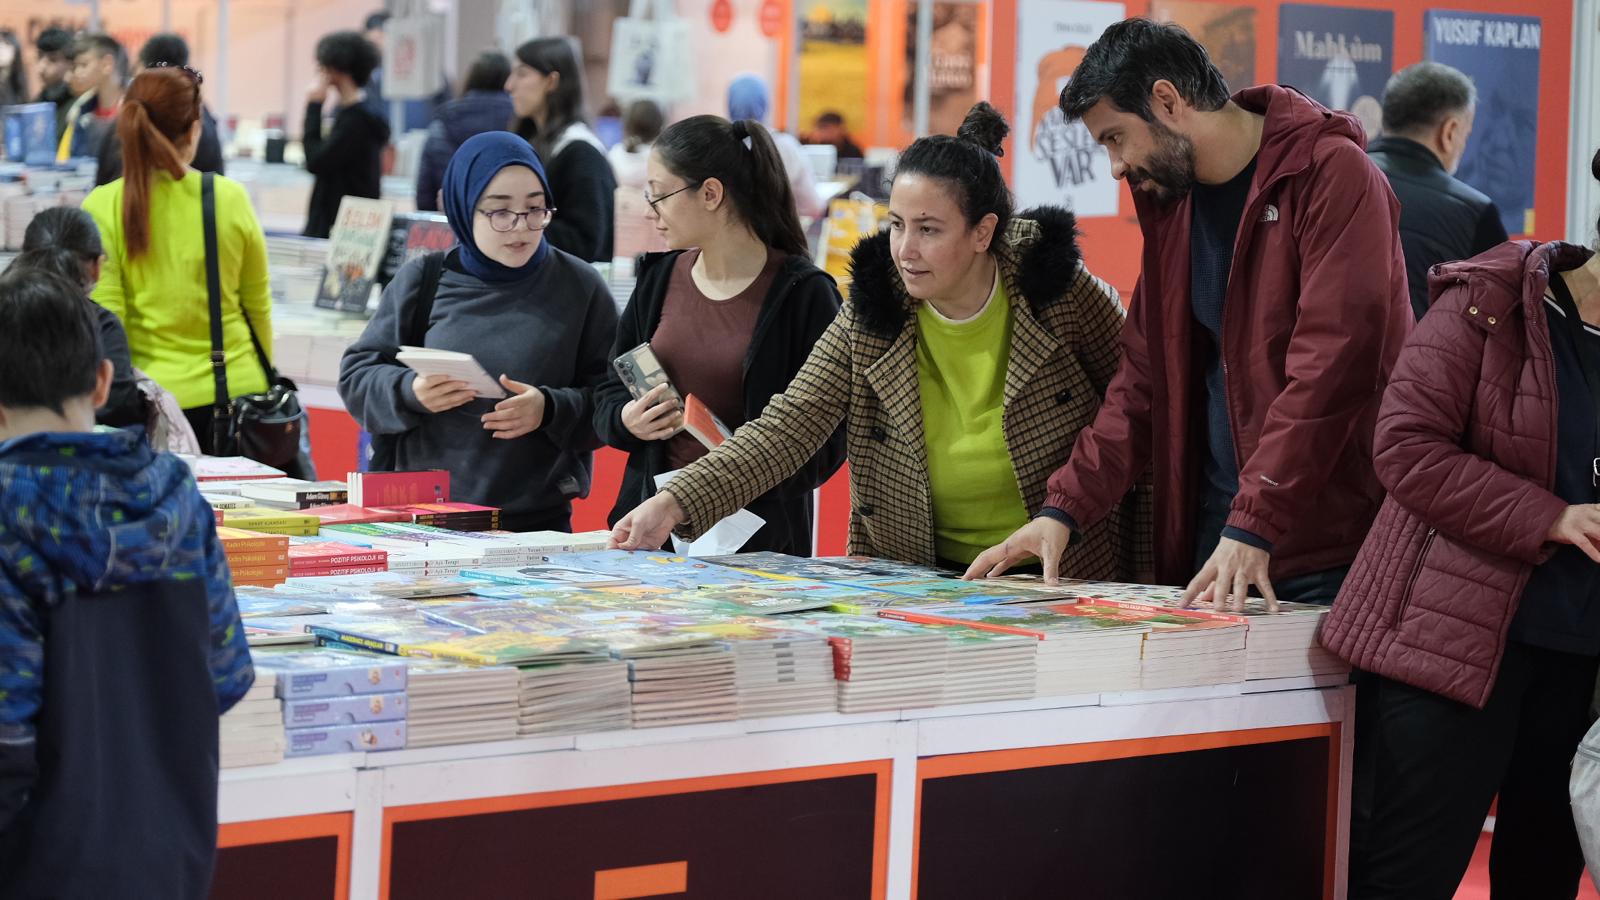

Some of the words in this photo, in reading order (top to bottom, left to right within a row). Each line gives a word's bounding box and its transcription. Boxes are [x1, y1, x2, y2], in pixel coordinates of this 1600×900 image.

[1433, 16, 1483, 45] YUSUF
[1484, 20, 1541, 49] KAPLAN
[1050, 149, 1096, 188] VAR
